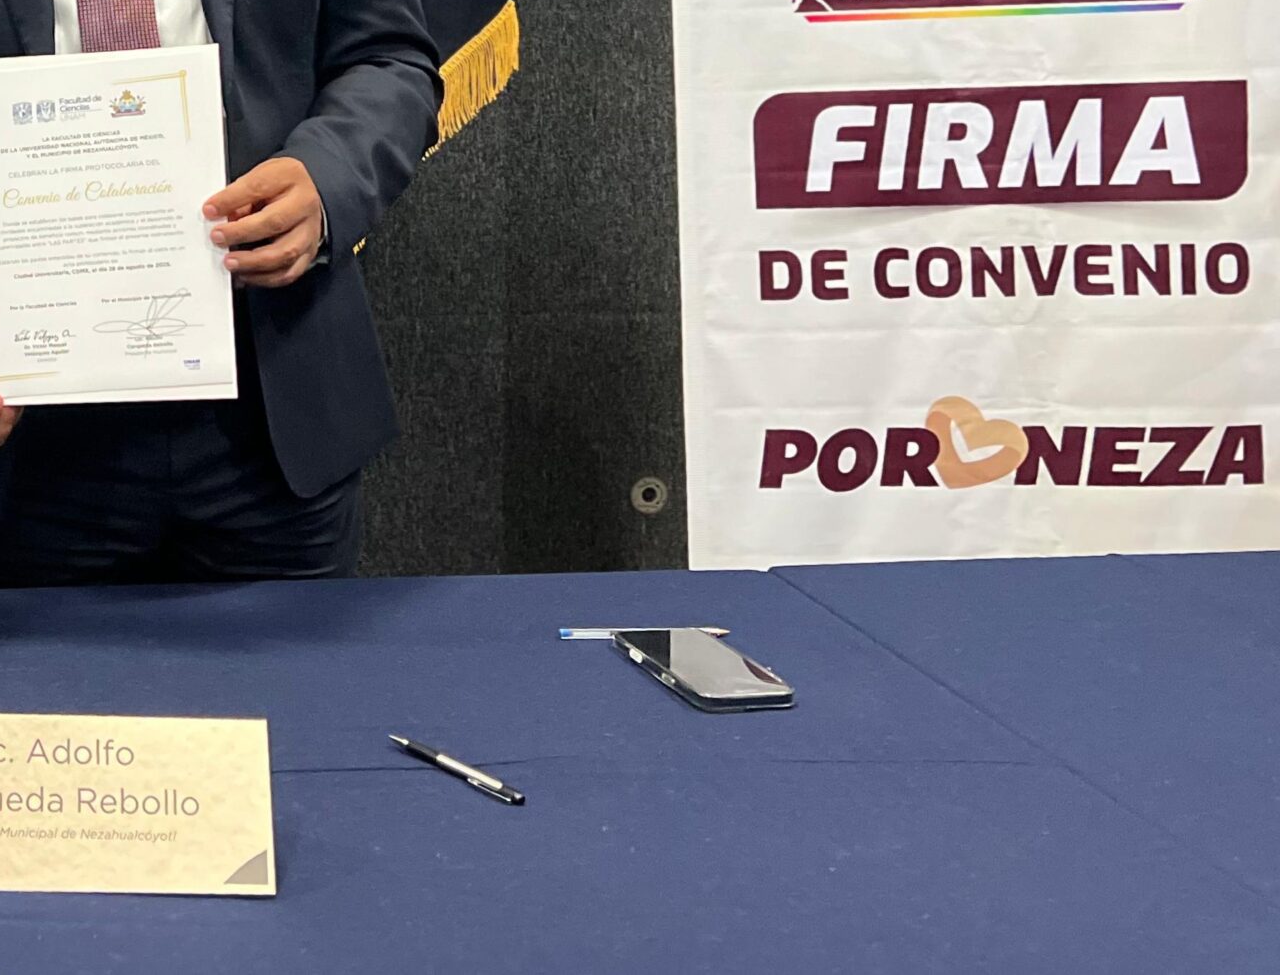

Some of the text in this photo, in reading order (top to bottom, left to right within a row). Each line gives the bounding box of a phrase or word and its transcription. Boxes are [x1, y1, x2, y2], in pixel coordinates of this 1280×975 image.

[59, 95, 92, 104] Facultad
[59, 104, 90, 112] Ciencias
[805, 96, 1202, 193] FIRMA
[8, 170, 48, 179] CELEBRAN
[60, 166, 83, 174] FIRMA
[85, 160, 144, 172] PROTOCOLARIA
[3, 180, 172, 208] Convenio de Colaboración
[758, 242, 1250, 300] DE CONVENIO
[758, 424, 1264, 492] POR NEZA
[26, 738, 134, 766] Adolfo
[77, 788, 200, 816] Rebollo
[0, 827, 58, 840] Municipal
[61, 829, 76, 839] de
[80, 830, 177, 843] Nezahualcóyotl
